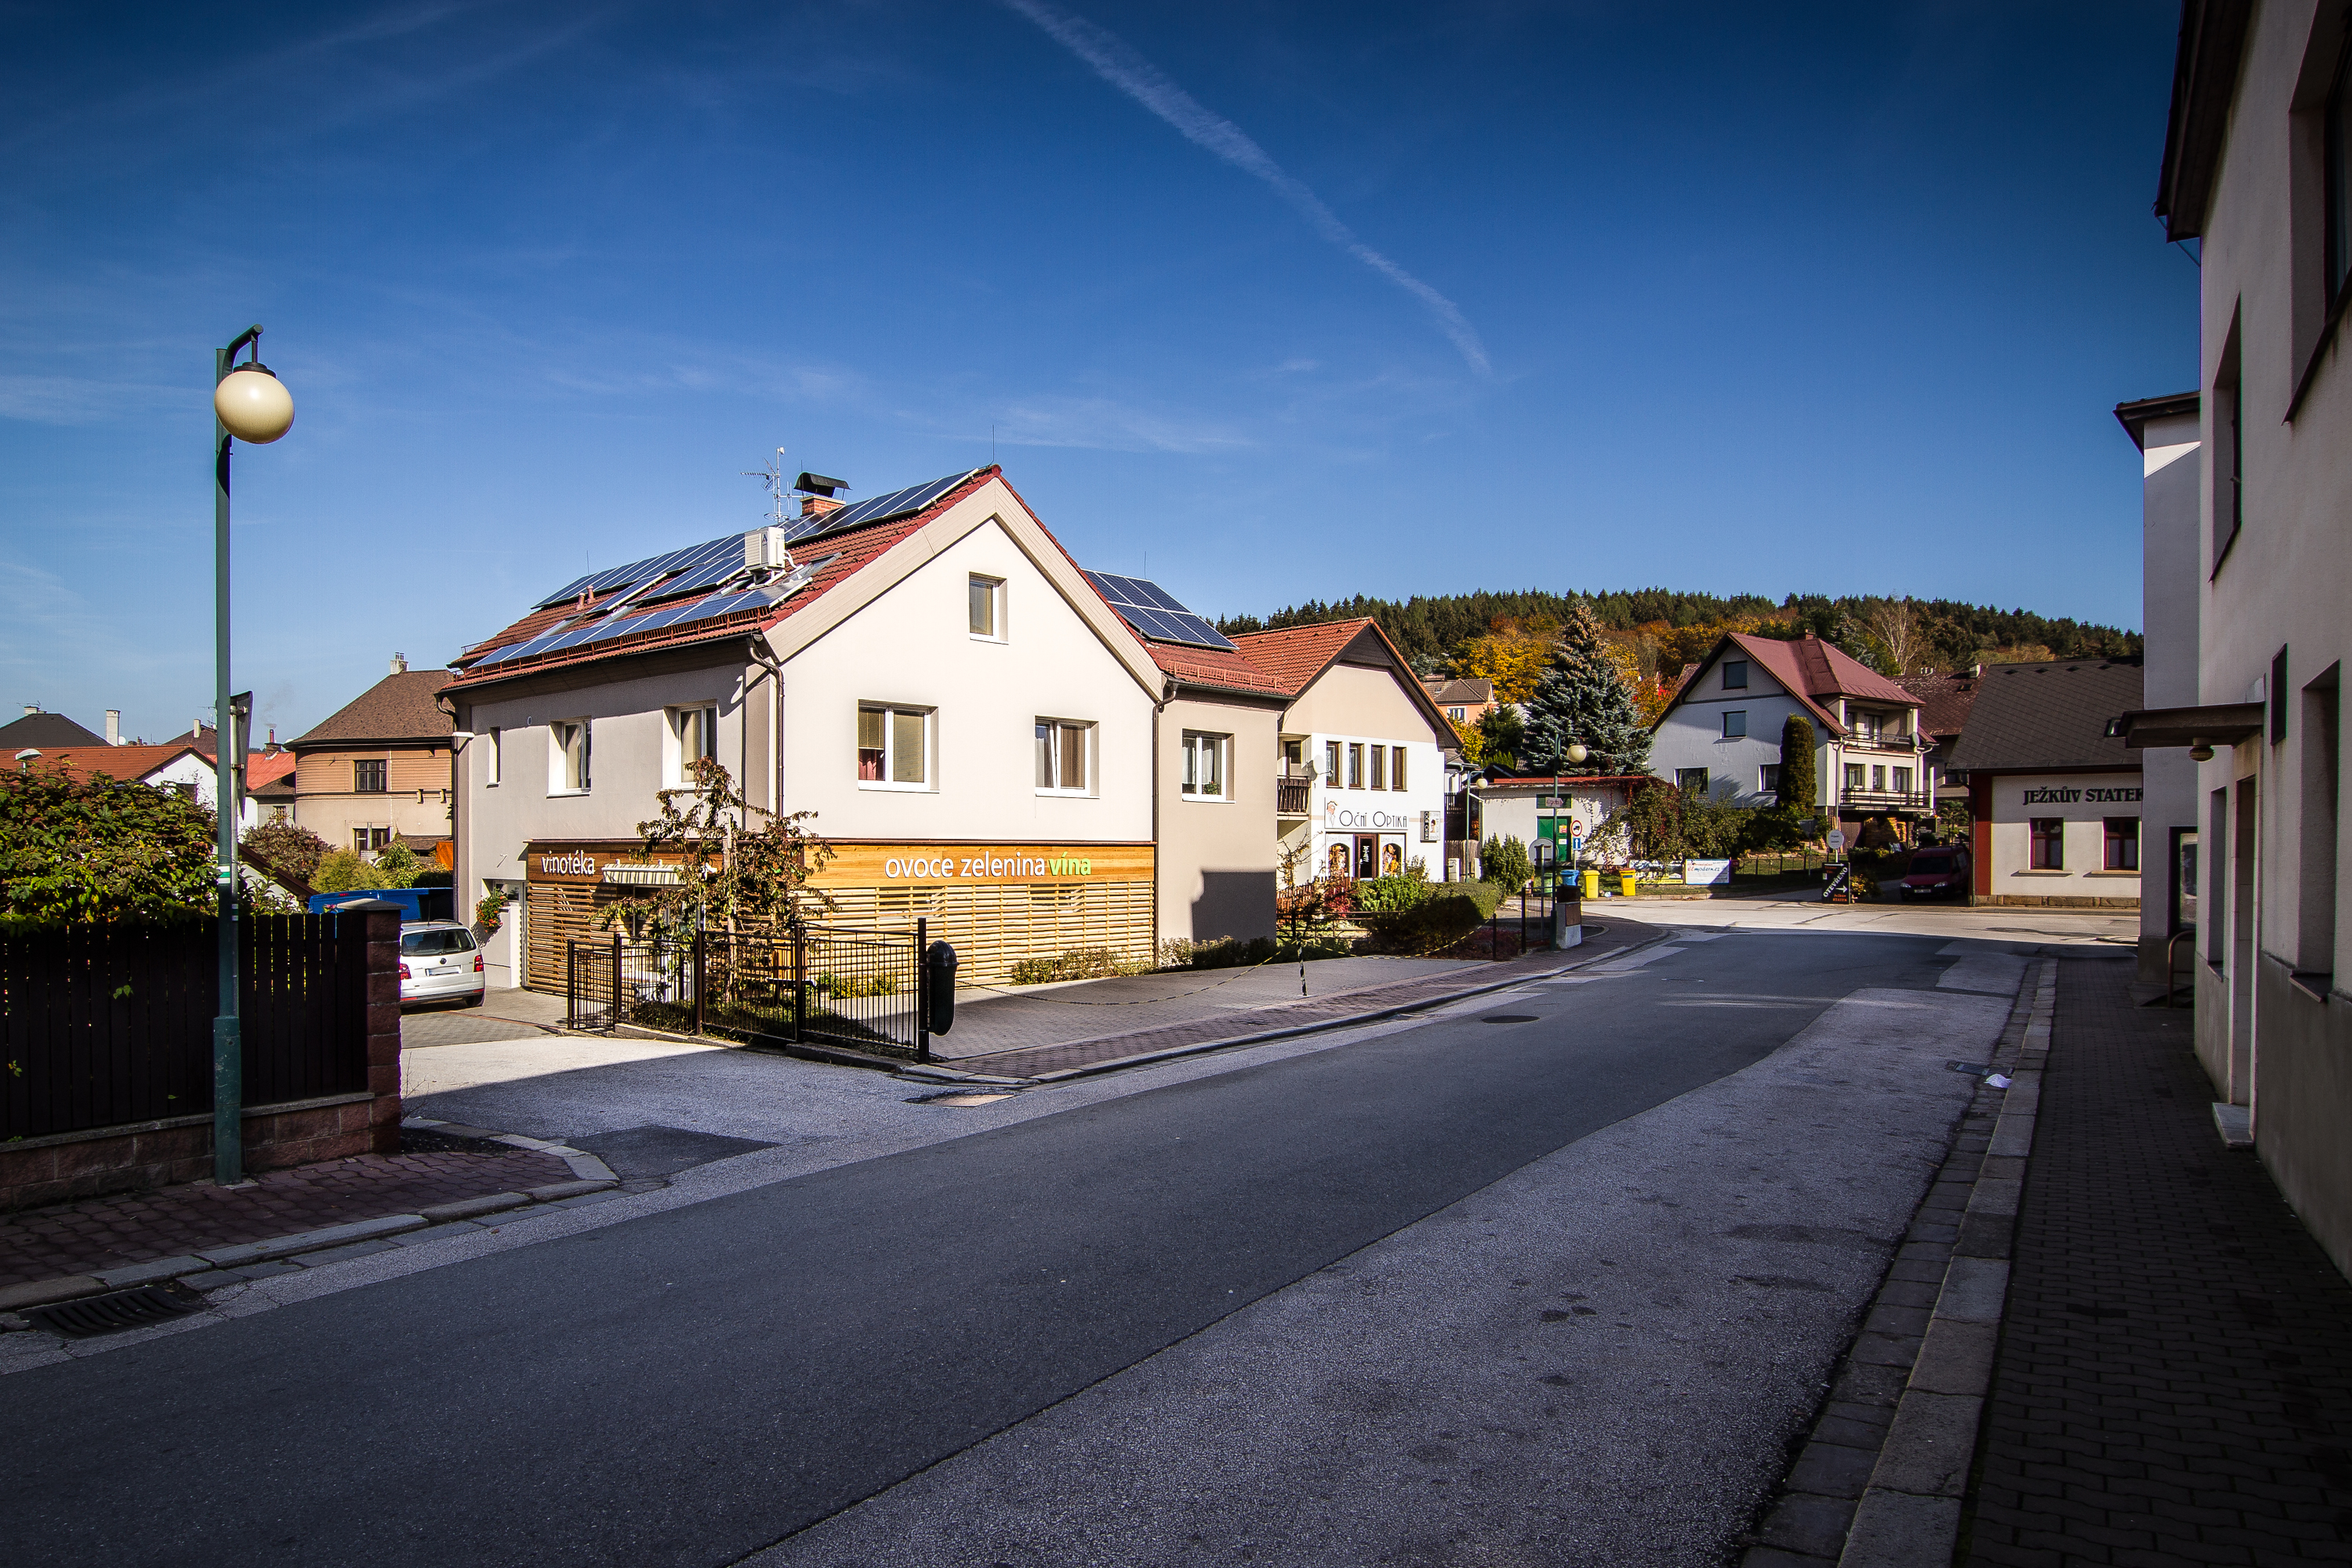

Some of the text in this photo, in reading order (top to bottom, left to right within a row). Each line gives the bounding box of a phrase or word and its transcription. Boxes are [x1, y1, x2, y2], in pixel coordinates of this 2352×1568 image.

[2023, 786, 2082, 806] JEŽKŮV
[541, 850, 596, 875] vinotéka
[885, 851, 1091, 878] ovoce zelenina vína
